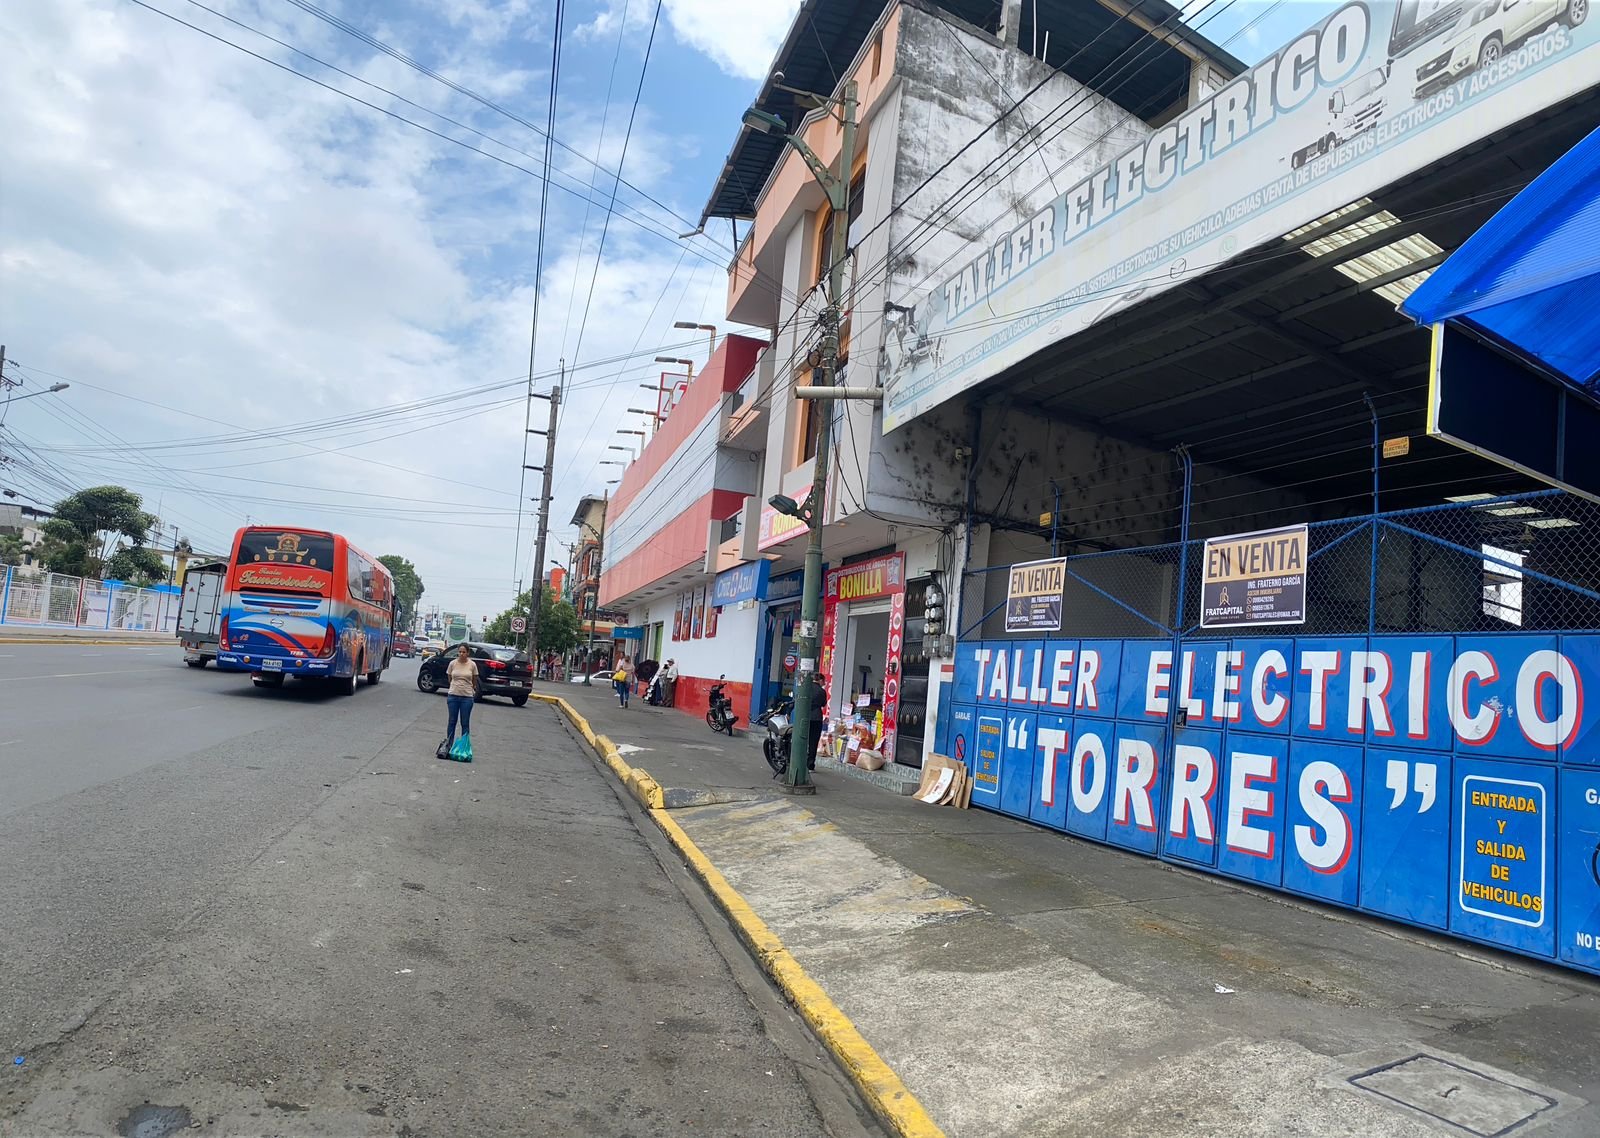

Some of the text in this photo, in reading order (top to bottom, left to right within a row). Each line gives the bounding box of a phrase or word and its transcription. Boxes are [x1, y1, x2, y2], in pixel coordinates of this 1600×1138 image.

[943, 3, 1369, 320] TALLER ELECTRICO
[1088, 268, 1116, 291] SISTEMA
[1159, 242, 1169, 259] DE
[1168, 233, 1181, 253] SU
[1181, 214, 1223, 246] VEHICULO,
[1224, 191, 1261, 226] ADEMAS
[1262, 174, 1294, 203] VENTA
[1295, 167, 1310, 188] DE
[1311, 131, 1376, 175] REPUESTOS
[1376, 90, 1455, 142] ELECTRICOS
[1456, 81, 1470, 104] Y
[1469, 28, 1570, 97] ACCESORIOS.
[1208, 538, 1301, 579] EN VENTA
[738, 569, 754, 592] Azul
[840, 569, 882, 600] BONILLA
[1012, 566, 1061, 594] EN VENTA
[1257, 578, 1281, 588] FRATERNO
[1282, 575, 1301, 586] GARCÍA
[1205, 606, 1244, 616] FRATCAPITAL
[973, 647, 1583, 752] TALLER ELECTRICO
[954, 711, 971, 720] GARAJE
[984, 761, 990, 769] DE
[1472, 791, 1536, 813] ENTRADA
[1497, 819, 1507, 834] Y
[1476, 840, 1527, 861] SALIDA
[1491, 864, 1509, 881] DE
[1462, 880, 1543, 912] VEHICULOS
[1576, 931, 1592, 948] NO
